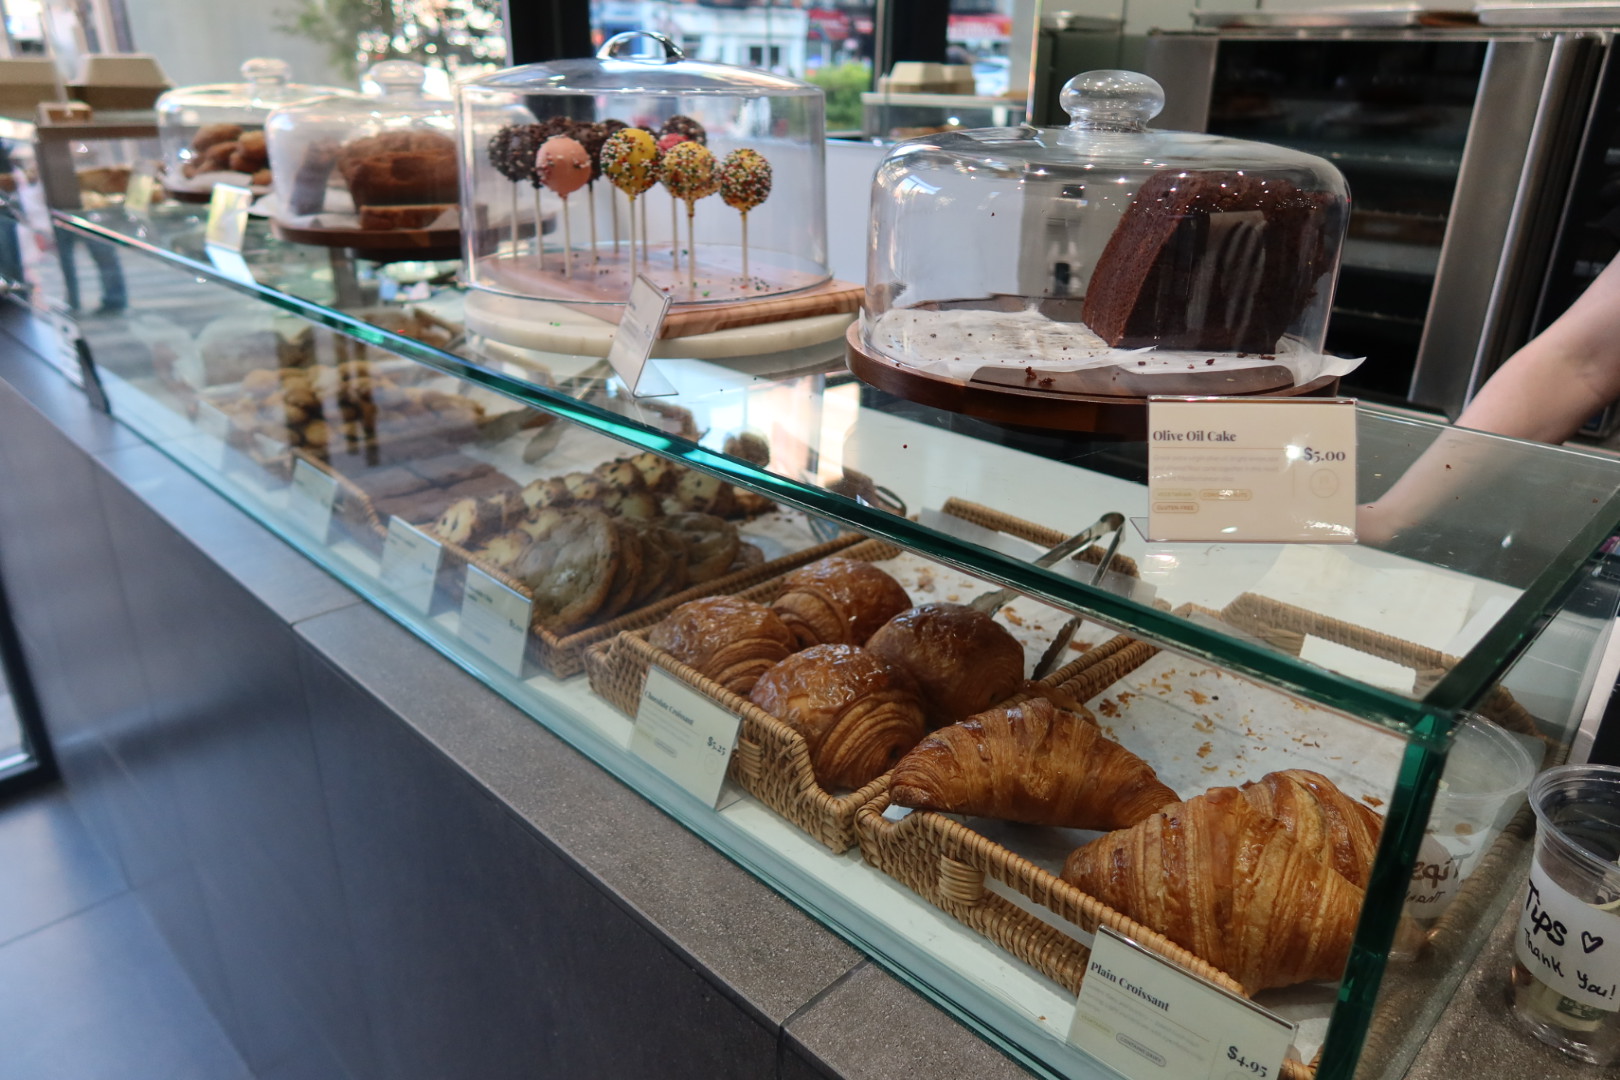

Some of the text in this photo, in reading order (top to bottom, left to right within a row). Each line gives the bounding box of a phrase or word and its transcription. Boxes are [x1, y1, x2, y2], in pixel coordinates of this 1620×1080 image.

[1152, 430, 1237, 442] Olive Oil Cake
[1304, 446, 1346, 463] $5.00
[1525, 878, 1568, 947] Tips
[1524, 927, 1564, 977] Thank
[1090, 961, 1170, 1012] Plain Croissant
[1226, 1045, 1268, 1079] $4.95
